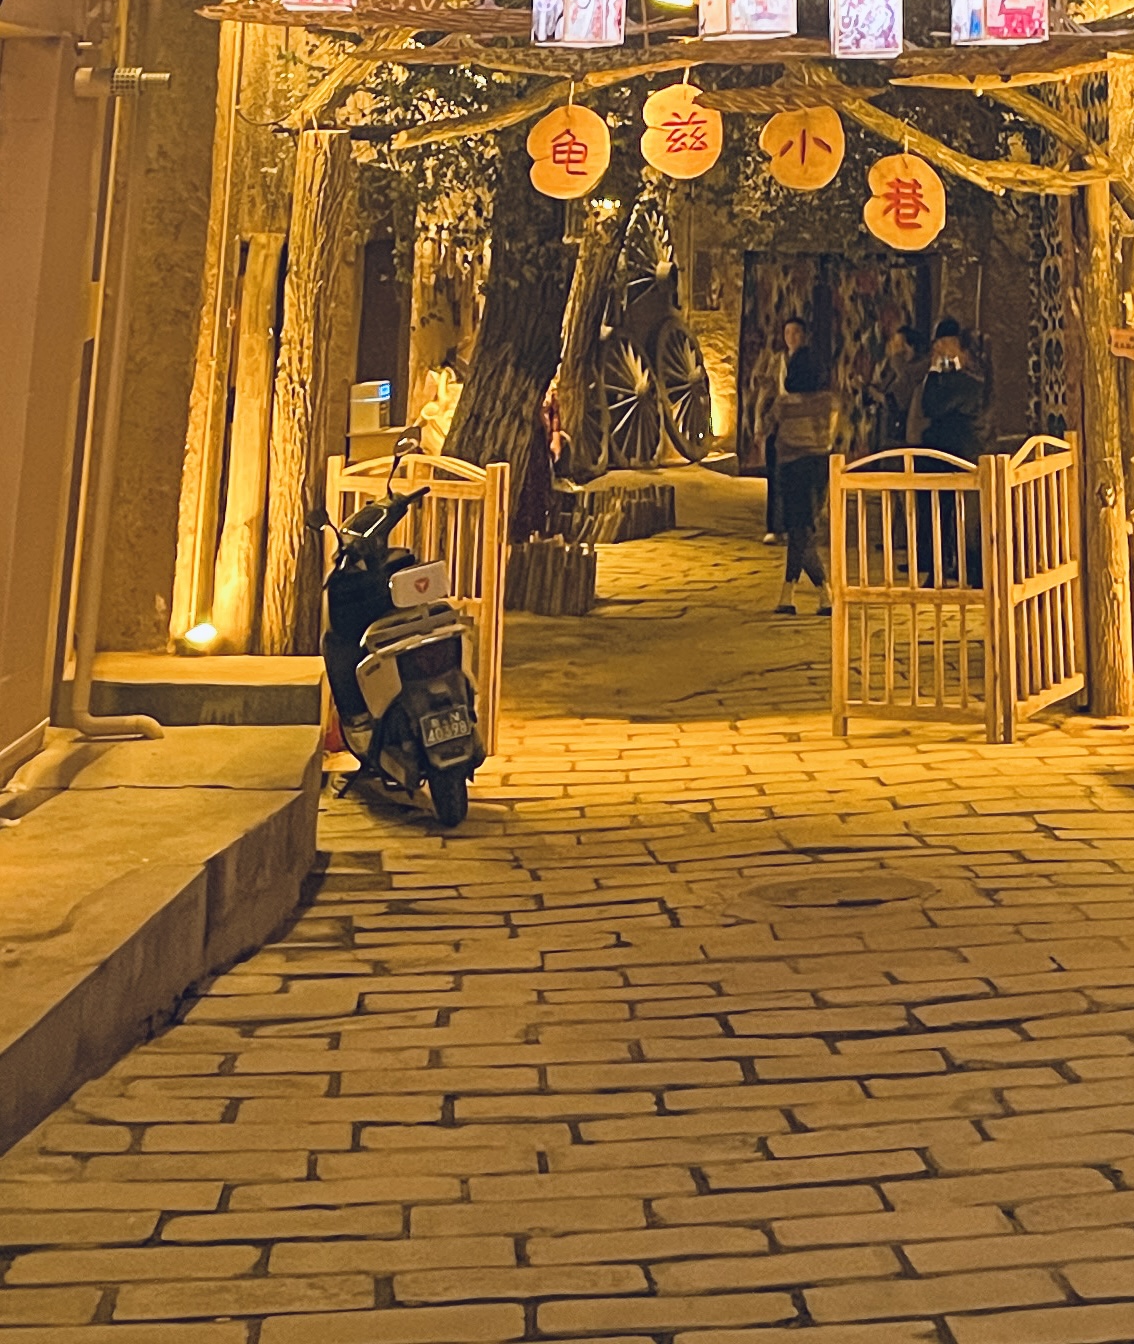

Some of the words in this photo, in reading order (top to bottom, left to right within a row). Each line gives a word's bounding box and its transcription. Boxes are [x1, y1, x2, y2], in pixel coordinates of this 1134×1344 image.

[550, 128, 589, 176] 龟
[660, 110, 709, 154] 兹
[778, 128, 833, 166] 小
[882, 177, 931, 230] 巷
